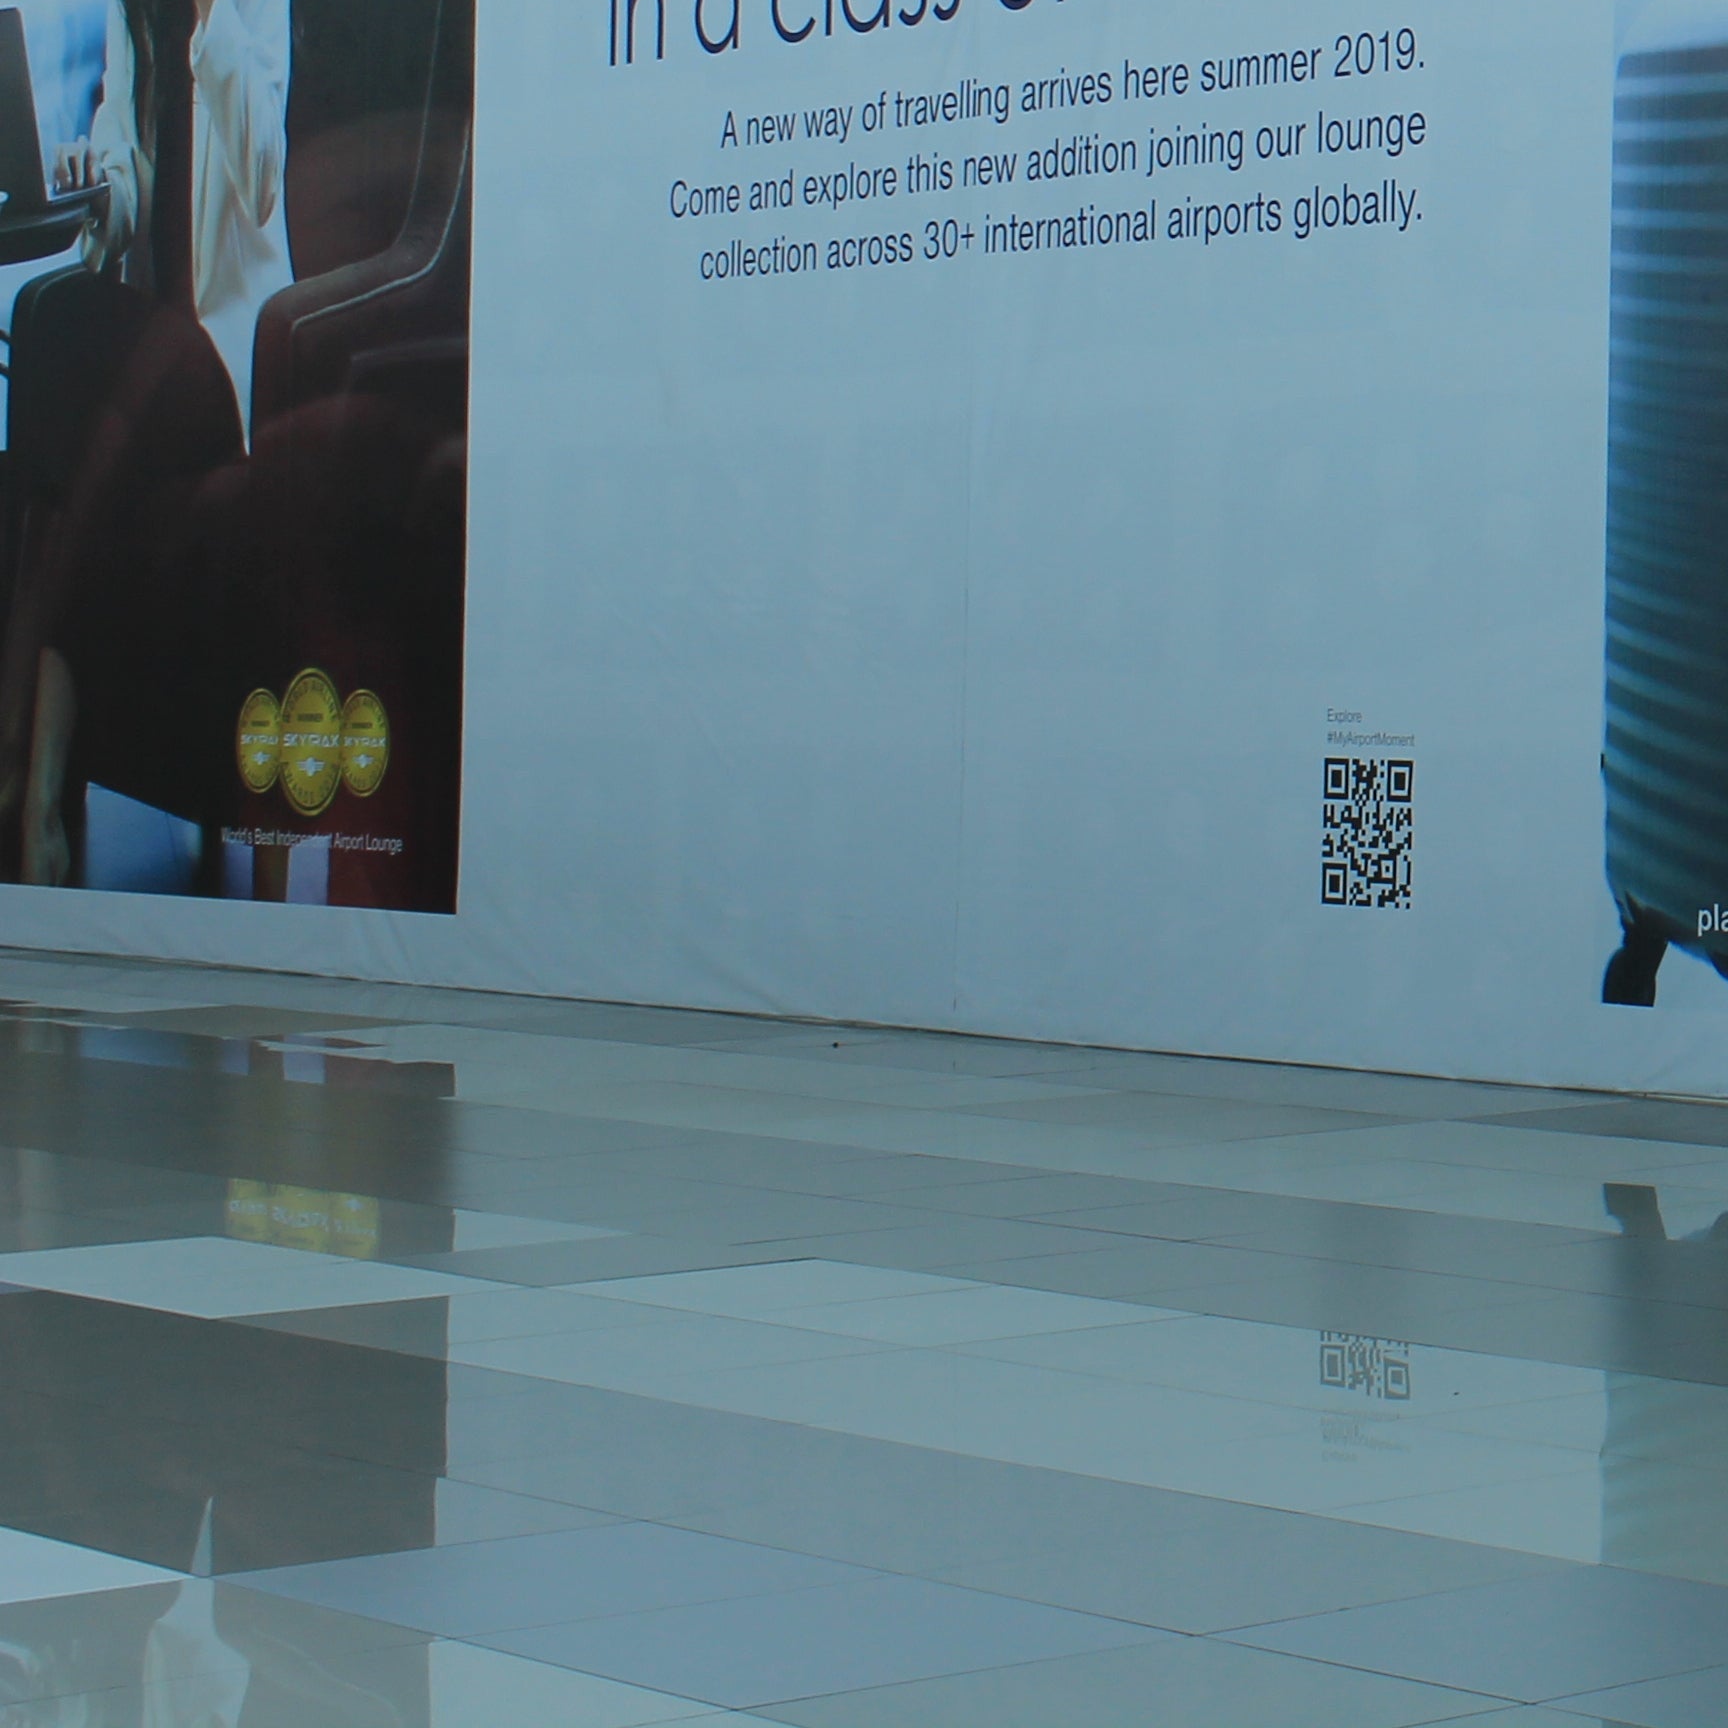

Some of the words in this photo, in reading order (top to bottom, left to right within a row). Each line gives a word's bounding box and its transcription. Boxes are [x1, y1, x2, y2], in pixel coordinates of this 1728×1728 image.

[720, 110, 739, 149] A
[745, 113, 796, 146] new
[803, 106, 853, 144] way
[861, 92, 889, 133] of
[894, 76, 1010, 129] travelling
[1020, 64, 1112, 112] arrives
[1124, 57, 1190, 101] here
[1200, 44, 1322, 92] summer
[1333, 27, 1425, 77] 2019.
[669, 176, 741, 219] Come
[749, 168, 794, 212] and
[803, 161, 897, 210] explore
[906, 150, 953, 195] this
[962, 154, 1017, 190] new
[1026, 133, 1137, 183] addition
[1146, 121, 1244, 177] joining
[1255, 123, 1307, 162] our
[1317, 108, 1427, 162] lounge
[700, 234, 817, 281] collection
[826, 232, 913, 269] across
[923, 220, 975, 260] 30+
[984, 200, 1157, 254] international
[1167, 190, 1283, 247] airports
[1294, 178, 1423, 239] globally.
[366, 833, 403, 855] Lounge
